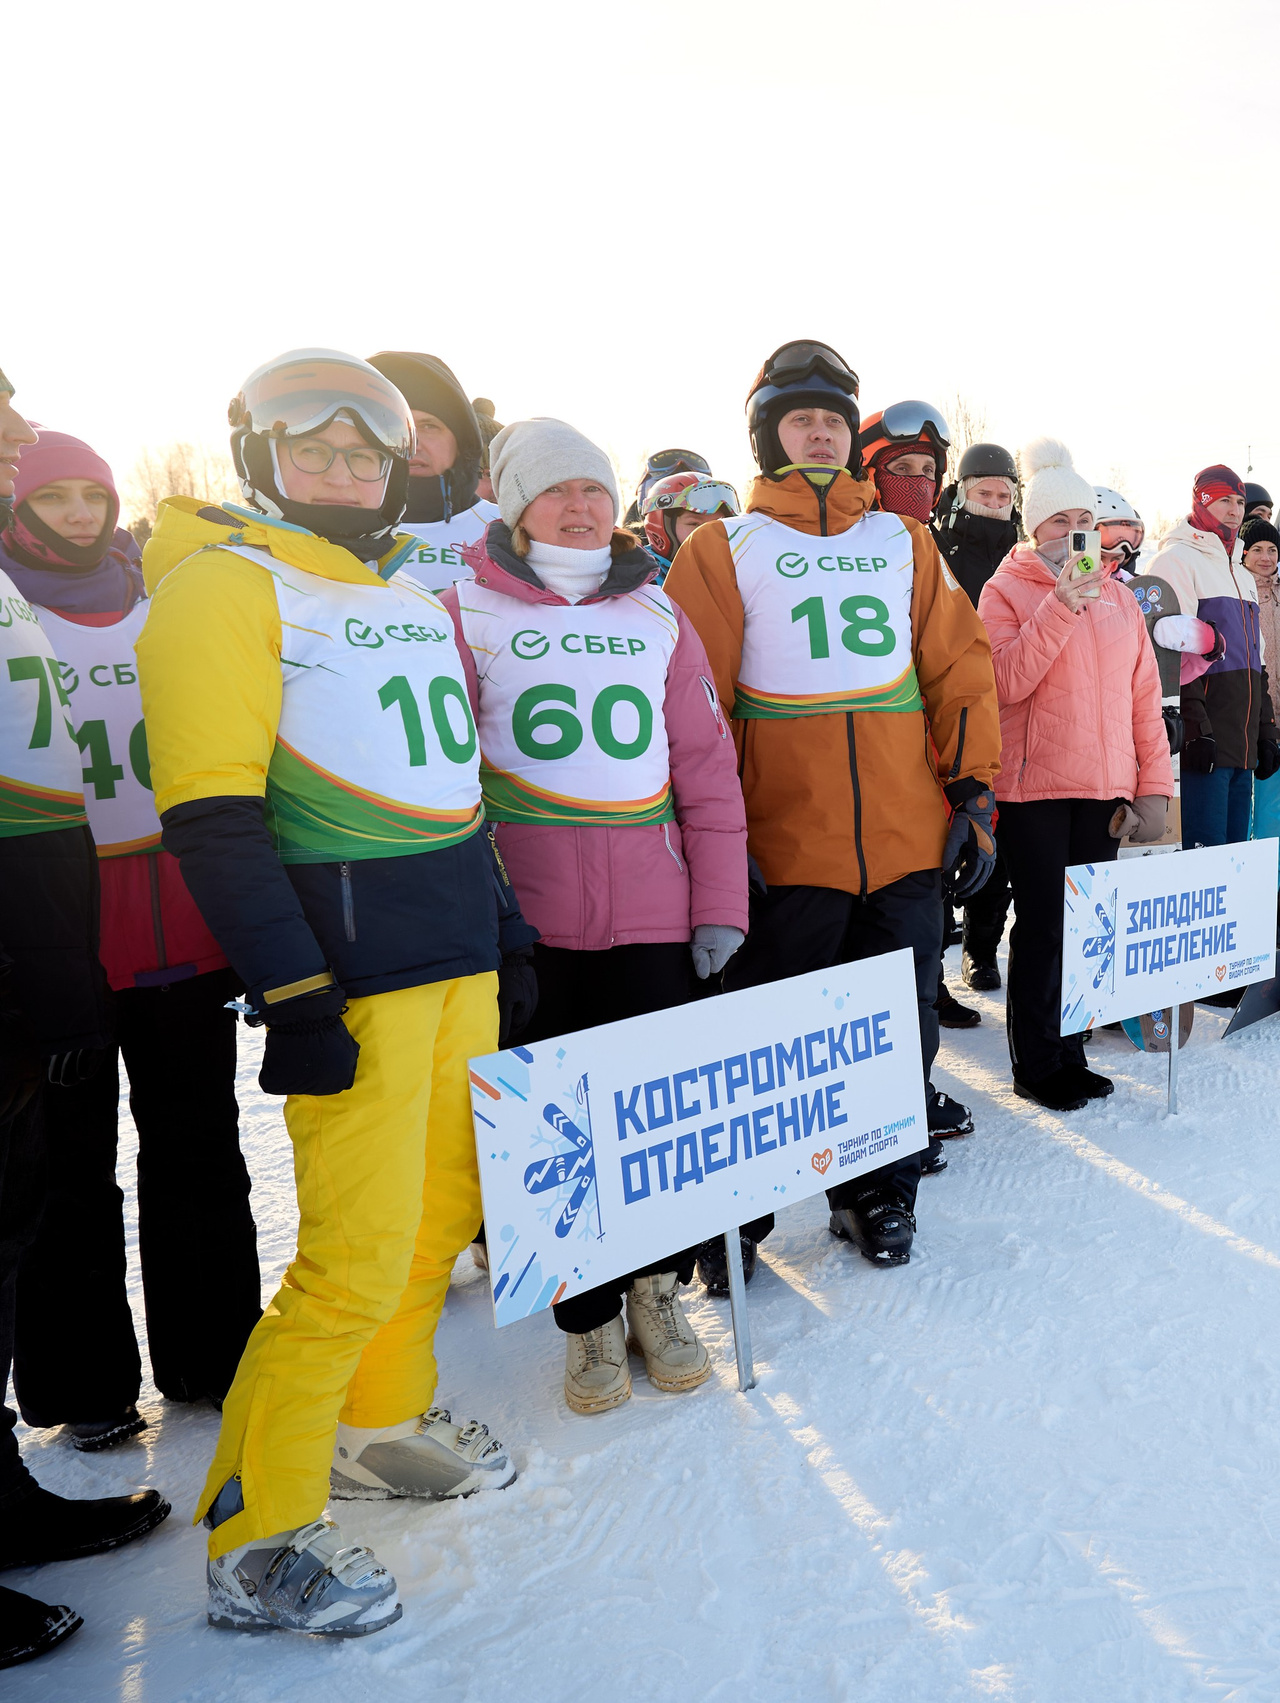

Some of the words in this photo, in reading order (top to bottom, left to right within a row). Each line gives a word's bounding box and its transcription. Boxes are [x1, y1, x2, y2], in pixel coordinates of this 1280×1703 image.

[817, 556, 888, 573] СБЕР
[384, 624, 448, 644] СБЕР
[560, 633, 646, 656] СБЕР
[791, 594, 897, 660] 18
[377, 675, 477, 768] 10
[512, 683, 654, 761] 60
[1126, 884, 1227, 935] ЗАПАДНОЕ
[1125, 920, 1237, 977] ОТДЕЛЕНИЕ
[613, 1010, 893, 1142] КОСТРОМСКОЕ
[620, 1080, 849, 1206] ОТДЕЛЕНИЕ
[837, 1132, 870, 1155] ТУРНИР
[870, 1127, 882, 1142] ПО
[883, 1114, 916, 1137] ЗИМНИМ
[838, 1146, 868, 1168] ВИДАМ
[868, 1134, 899, 1156] СПОРТА
